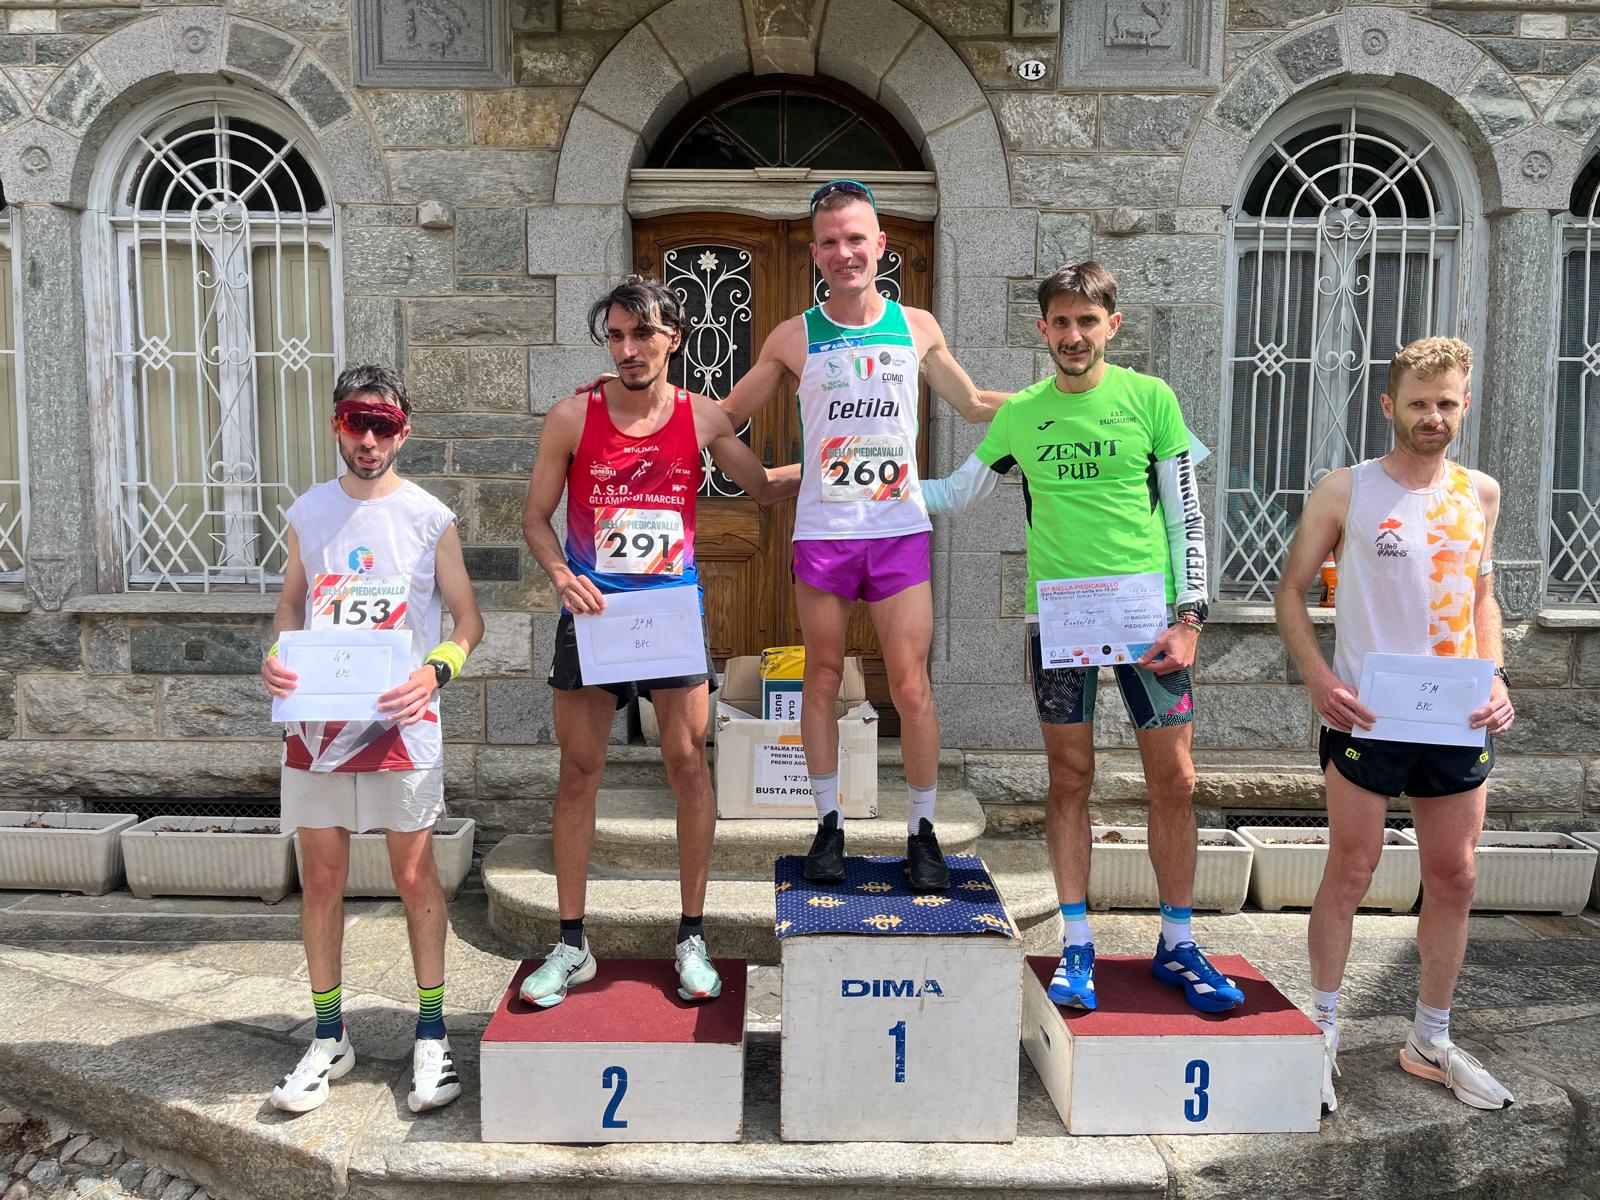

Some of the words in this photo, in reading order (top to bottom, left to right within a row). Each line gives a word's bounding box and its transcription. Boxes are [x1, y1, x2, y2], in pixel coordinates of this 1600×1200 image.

[1023, 63, 1041, 77] 14
[1099, 416, 1137, 426] BRANCALEONE
[853, 446, 904, 457] PIEDICAVALLO
[1036, 439, 1122, 462] ZENIT
[829, 460, 900, 487] 260
[1057, 462, 1100, 480] PUB
[592, 484, 633, 496] A.S.D.
[626, 520, 680, 531] PIEDICAVALLO
[607, 532, 670, 559] 291
[1185, 546, 1206, 592] KEEP
[350, 585, 405, 597] PIEDICAVALLO
[329, 598, 391, 626] 153
[635, 639, 651, 649] BPC
[1415, 700, 1434, 712] BPC
[755, 787, 788, 795] BUSTA
[841, 979, 945, 998] DIMA
[888, 1020, 906, 1083] 1
[602, 1065, 628, 1128] 2
[1184, 1059, 1210, 1122] 3
